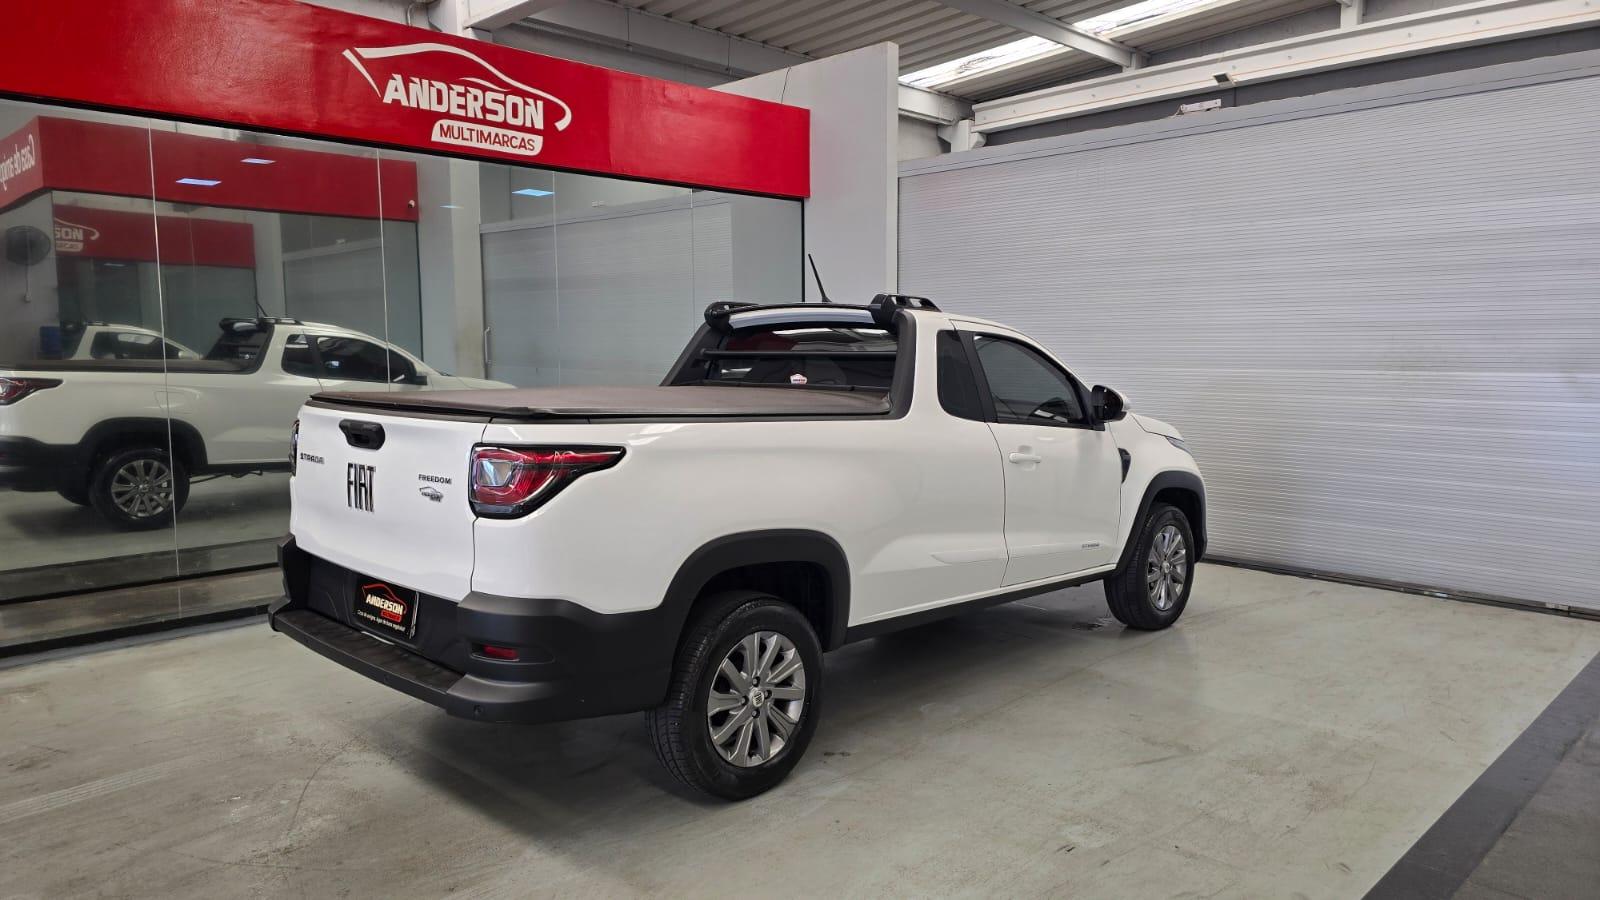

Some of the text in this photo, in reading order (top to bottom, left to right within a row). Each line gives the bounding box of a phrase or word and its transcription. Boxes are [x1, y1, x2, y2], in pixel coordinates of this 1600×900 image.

[383, 74, 544, 130] ANDERSON
[439, 123, 536, 151] MULTIMARCAS
[347, 462, 376, 513] FIAT
[418, 474, 452, 485] FREEDOM
[365, 593, 404, 616] ANDERSON
